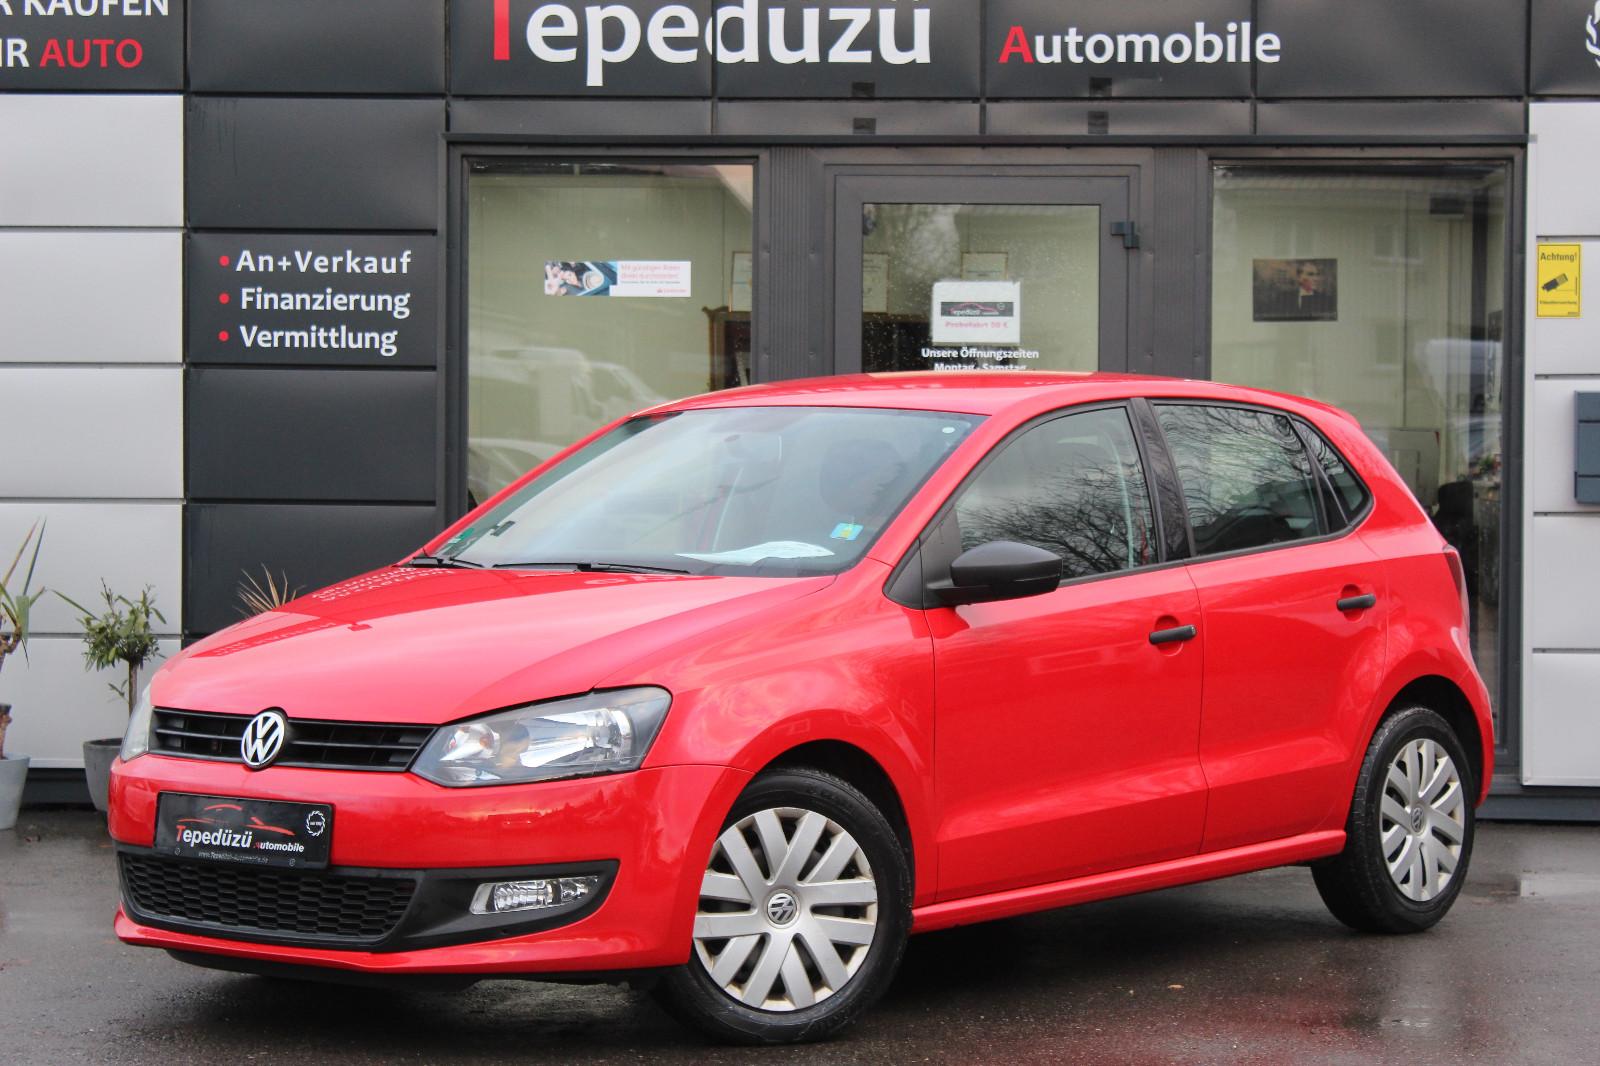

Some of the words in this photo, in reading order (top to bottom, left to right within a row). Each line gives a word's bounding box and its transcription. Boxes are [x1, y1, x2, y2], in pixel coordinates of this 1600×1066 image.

[24, 0, 169, 16] KAUFEN
[0, 38, 30, 68] R
[39, 38, 144, 69] AUTO
[998, 22, 1281, 64] Automobile
[235, 250, 412, 274] An+Verkauf
[241, 287, 411, 319] Finanzierung
[239, 325, 398, 357] Vermittlung
[921, 348, 959, 358] Unsere
[960, 346, 1039, 361] Öffnungszeiten
[176, 825, 253, 848] Tepedüzü
